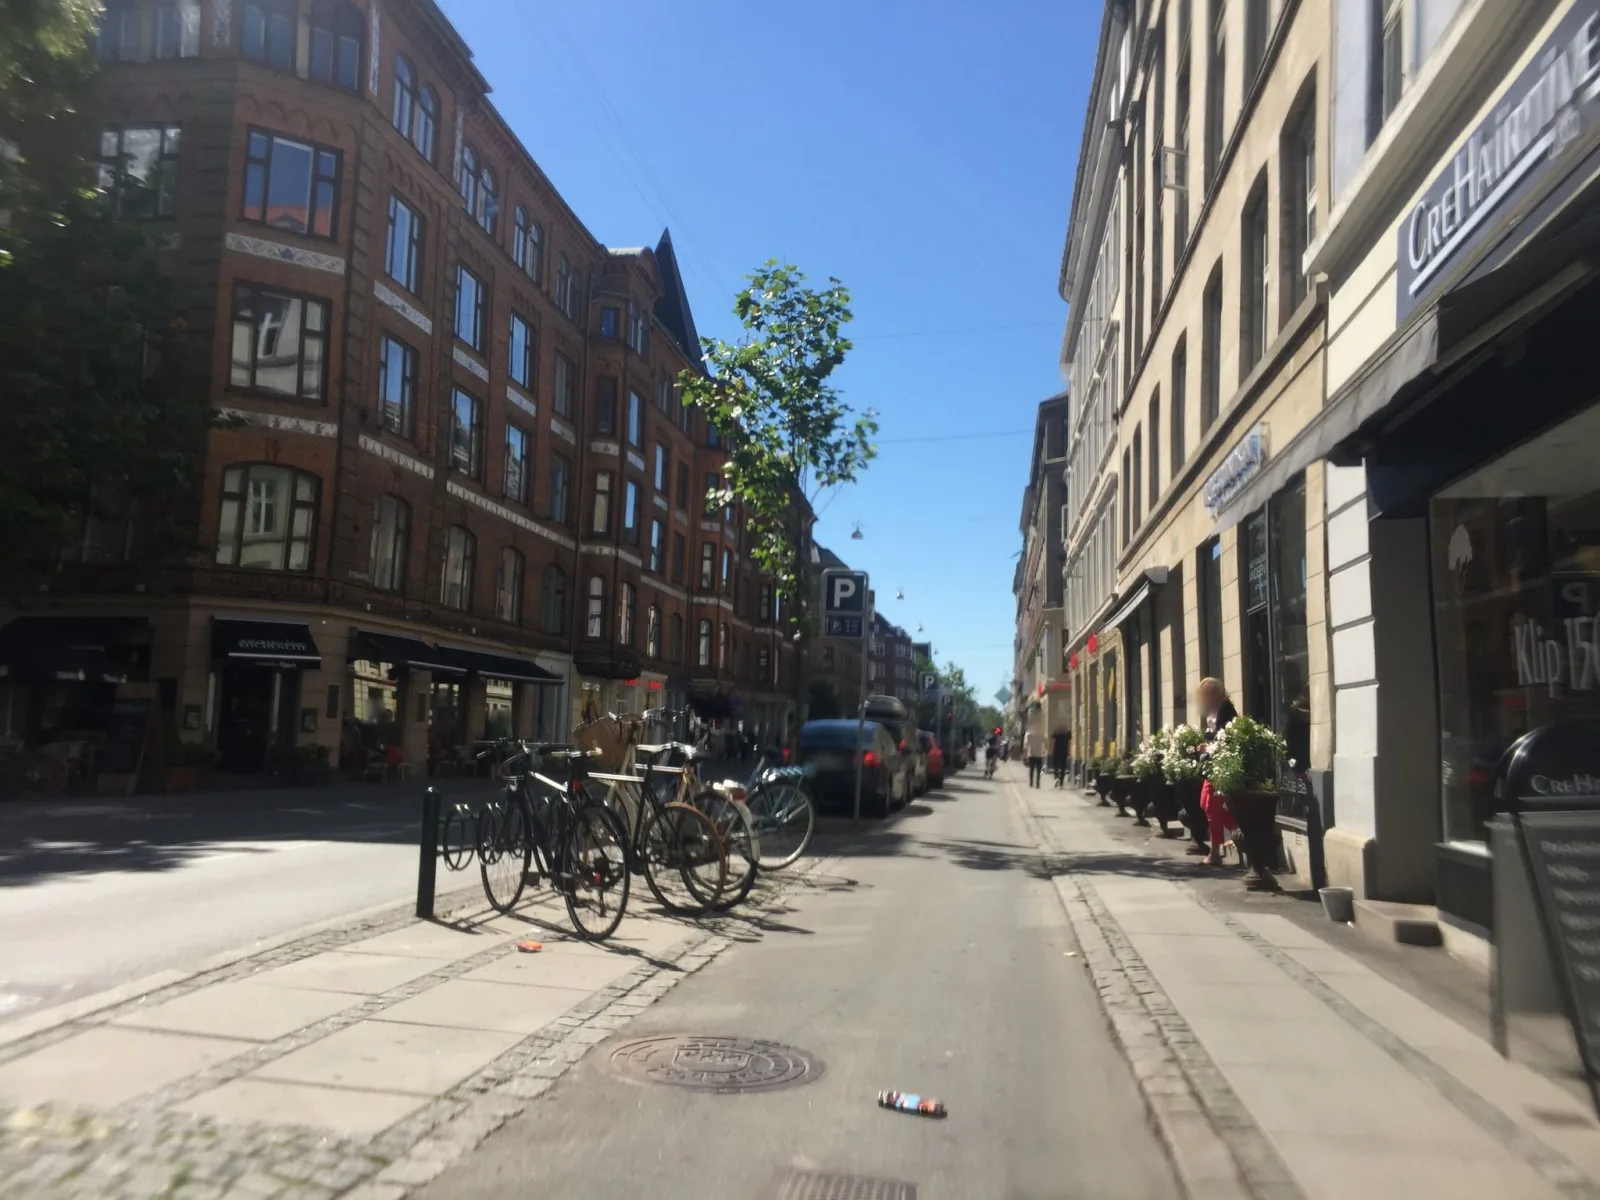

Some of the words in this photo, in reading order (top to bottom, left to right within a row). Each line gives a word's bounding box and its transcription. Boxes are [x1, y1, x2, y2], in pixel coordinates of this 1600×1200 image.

[834, 578, 856, 608] P
[1513, 617, 1561, 700] Klip
[925, 675, 935, 689] P
